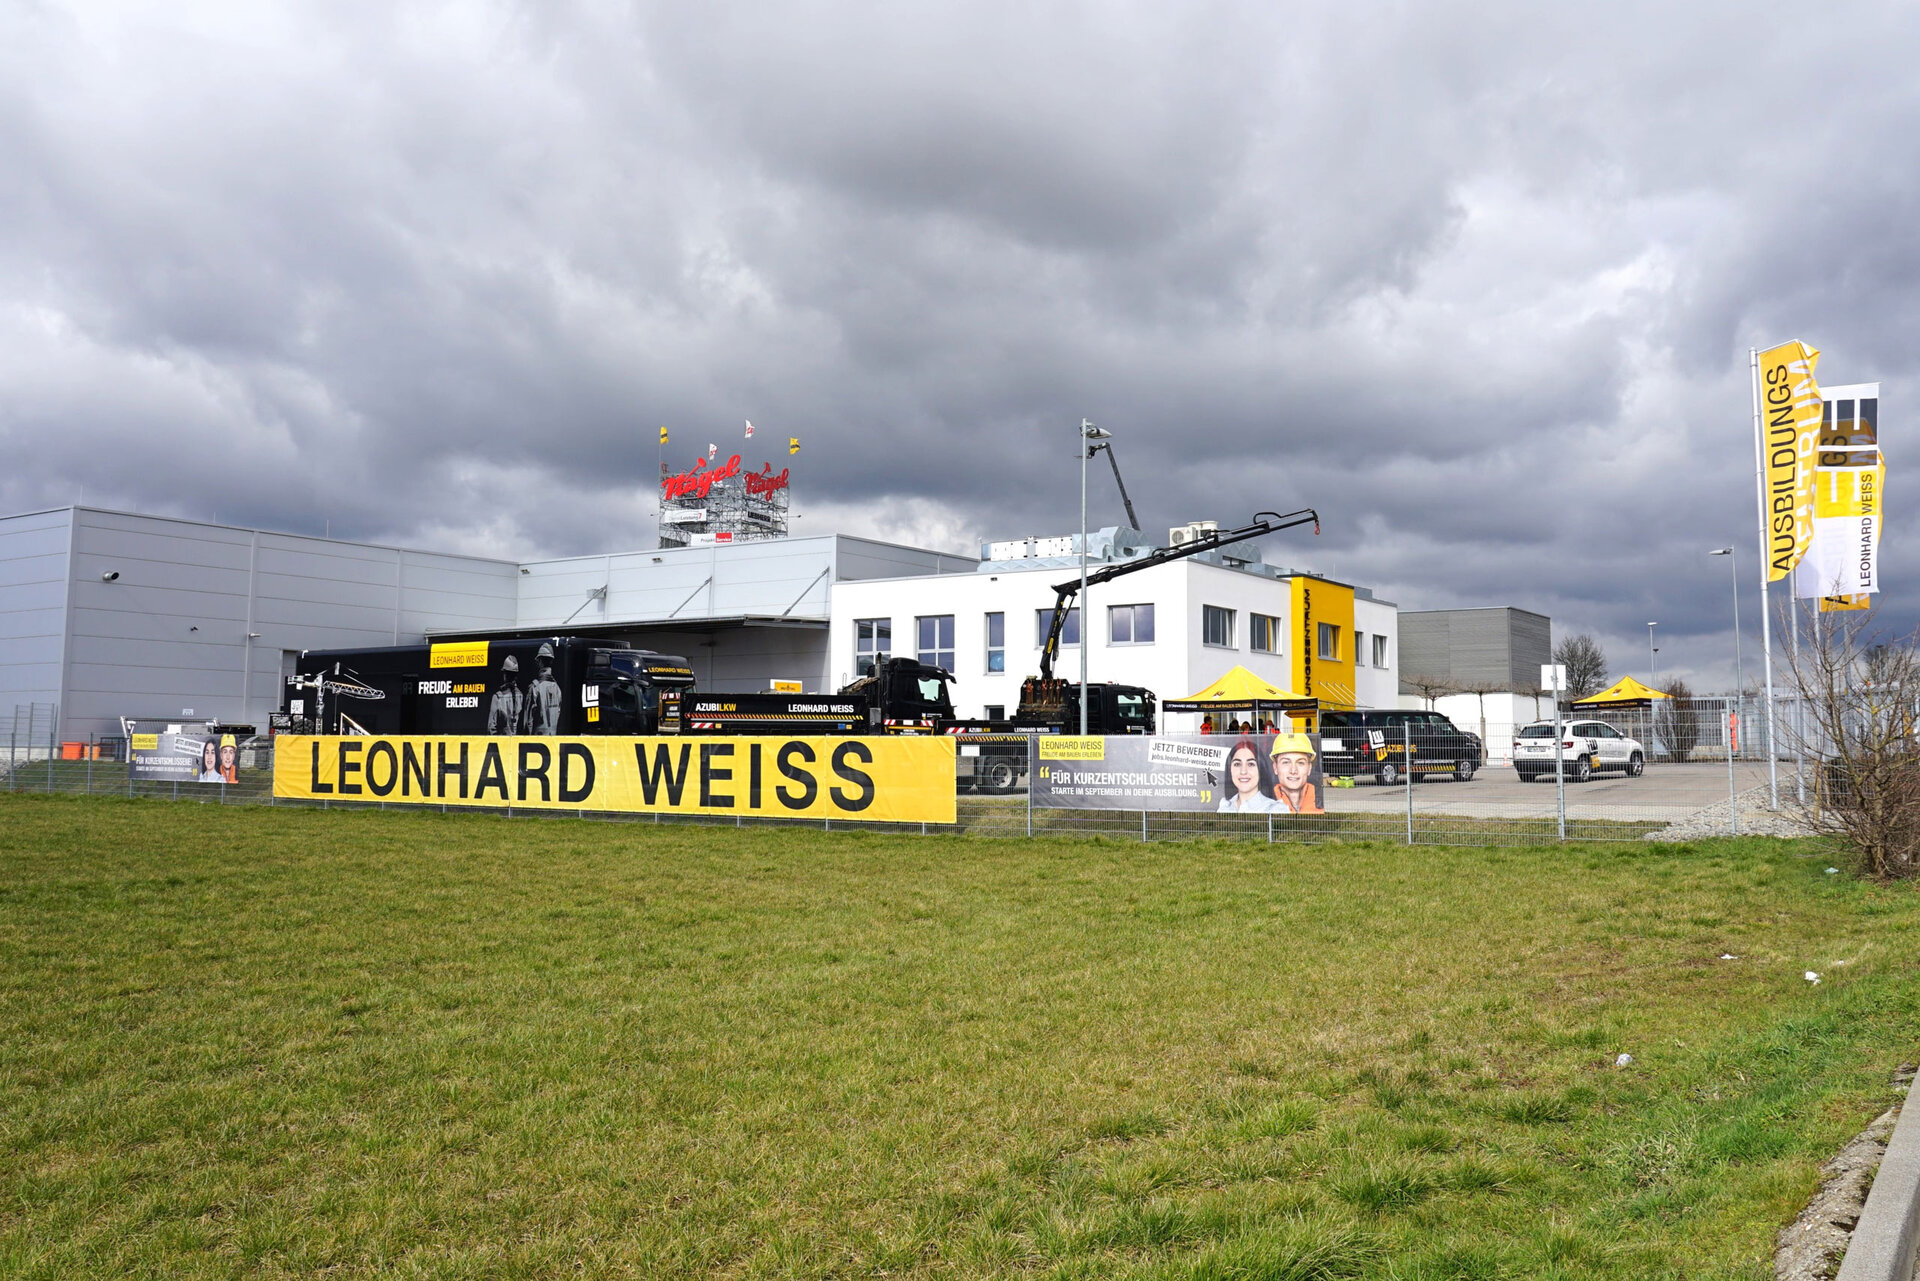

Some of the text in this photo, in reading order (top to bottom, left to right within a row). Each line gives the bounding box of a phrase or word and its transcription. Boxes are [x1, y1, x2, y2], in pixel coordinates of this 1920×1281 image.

[1788, 359, 1822, 556] ENTRUM
[1766, 364, 1796, 572] AUSBILDUNGS
[662, 454, 741, 500] Nagel
[1860, 474, 1873, 515] WEISS
[1860, 517, 1872, 587] LEONHARD
[433, 654, 485, 666] LEONHARD WEISS
[418, 681, 485, 695] FREUDE AM BAUEN
[446, 696, 478, 708] ERLEBEN
[695, 703, 736, 712] AZUBILKW
[788, 703, 854, 713] LEONHARD WEISS
[1041, 741, 1102, 750] LEONHARD WEISS
[1152, 742, 1221, 758] JETZT BEWERBEN!
[1151, 753, 1221, 767] jobs.leonhard-weiss.com
[311, 740, 876, 812] LEONHARD WEISS
[1074, 771, 1198, 786] KURZENTSCHLOSSENE!
[1051, 787, 1199, 797] STARTE IM SEPTEMBER IN DEINE AUSBILDUNG.
